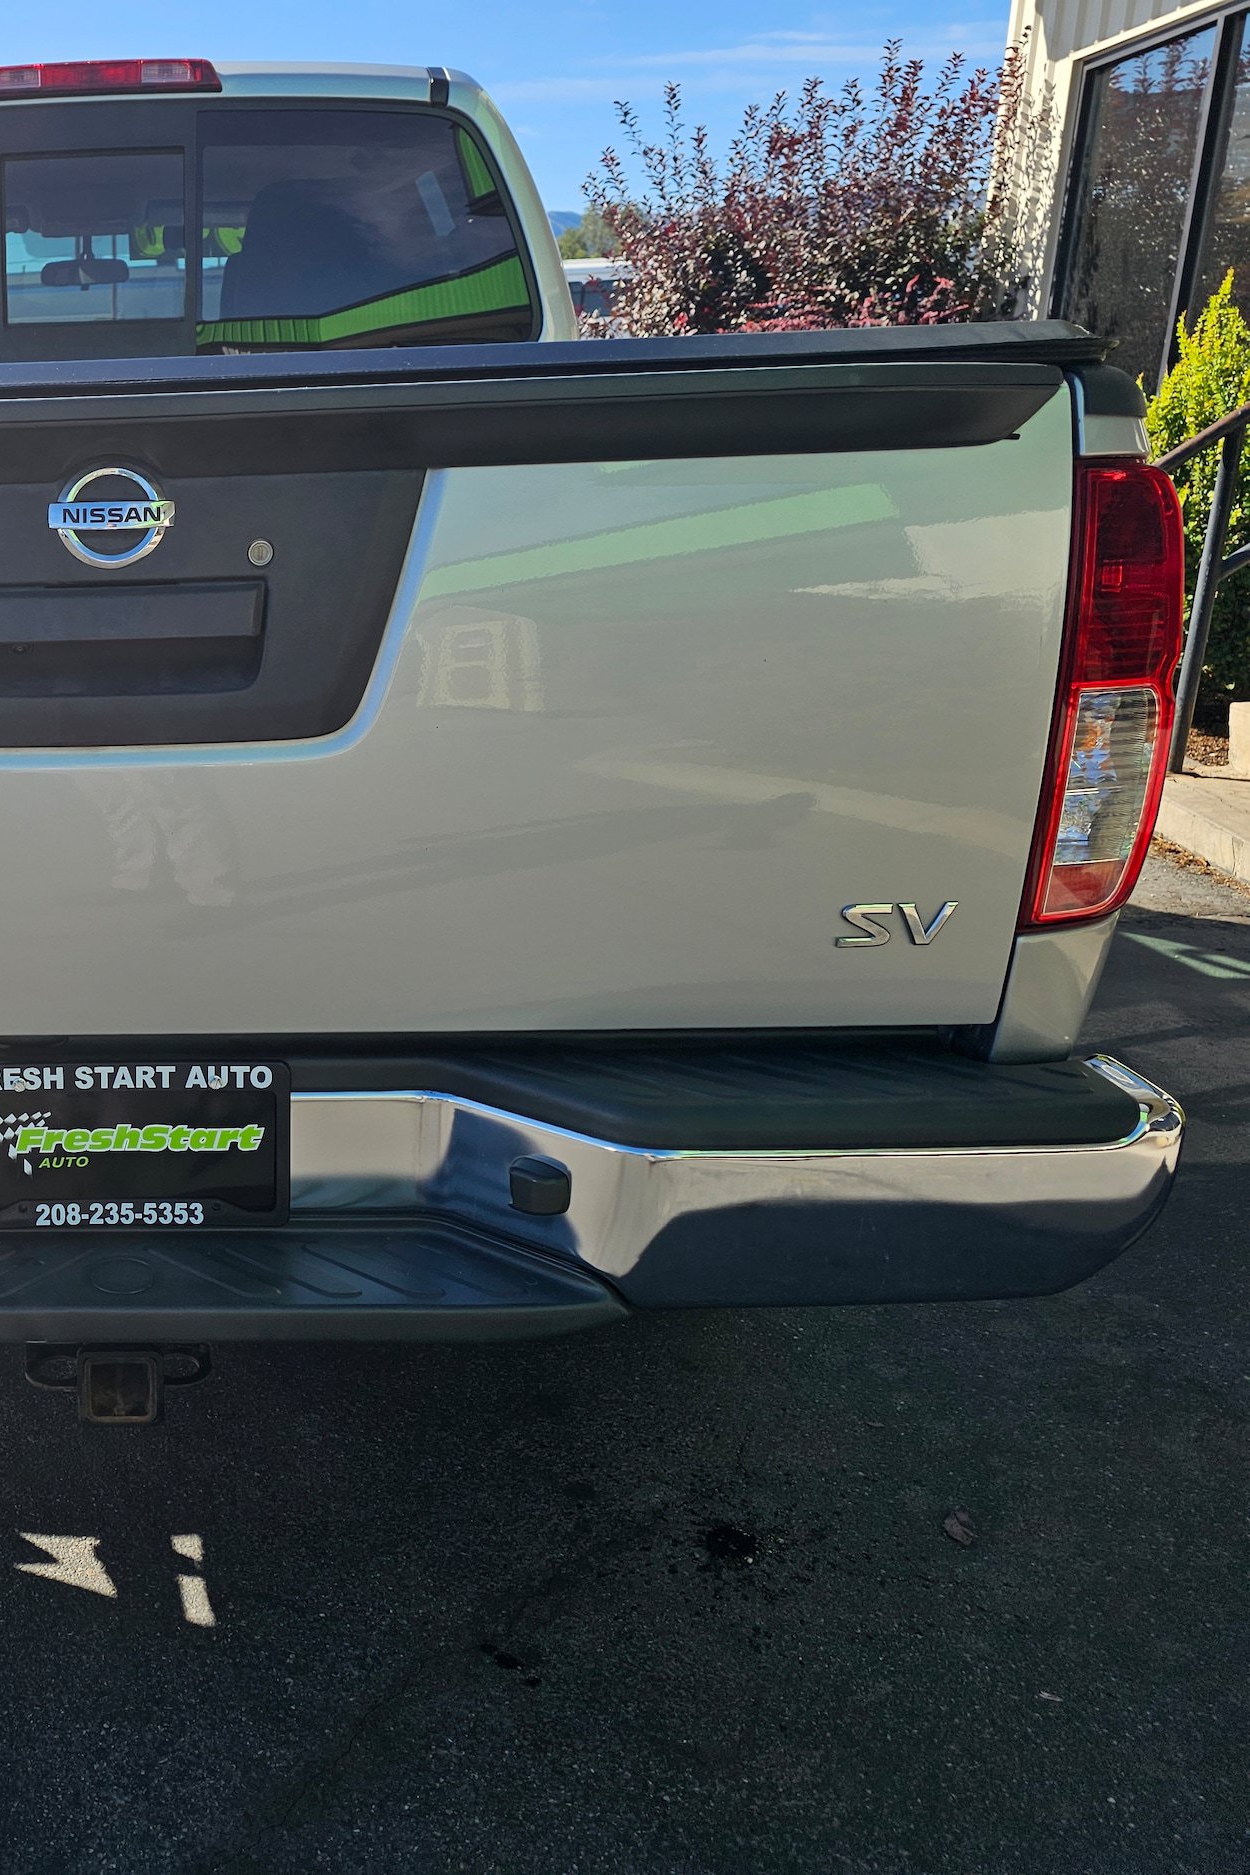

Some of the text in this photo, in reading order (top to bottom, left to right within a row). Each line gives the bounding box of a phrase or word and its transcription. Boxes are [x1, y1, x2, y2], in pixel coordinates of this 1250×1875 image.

[62, 506, 161, 524] NISSAN
[835, 901, 959, 948] SV
[74, 1065, 176, 1090] START
[185, 1065, 273, 1090] AUTO
[15, 1123, 265, 1153] FreshStart
[38, 1156, 90, 1169] AUTO
[35, 1202, 205, 1226] 208-235-5353
